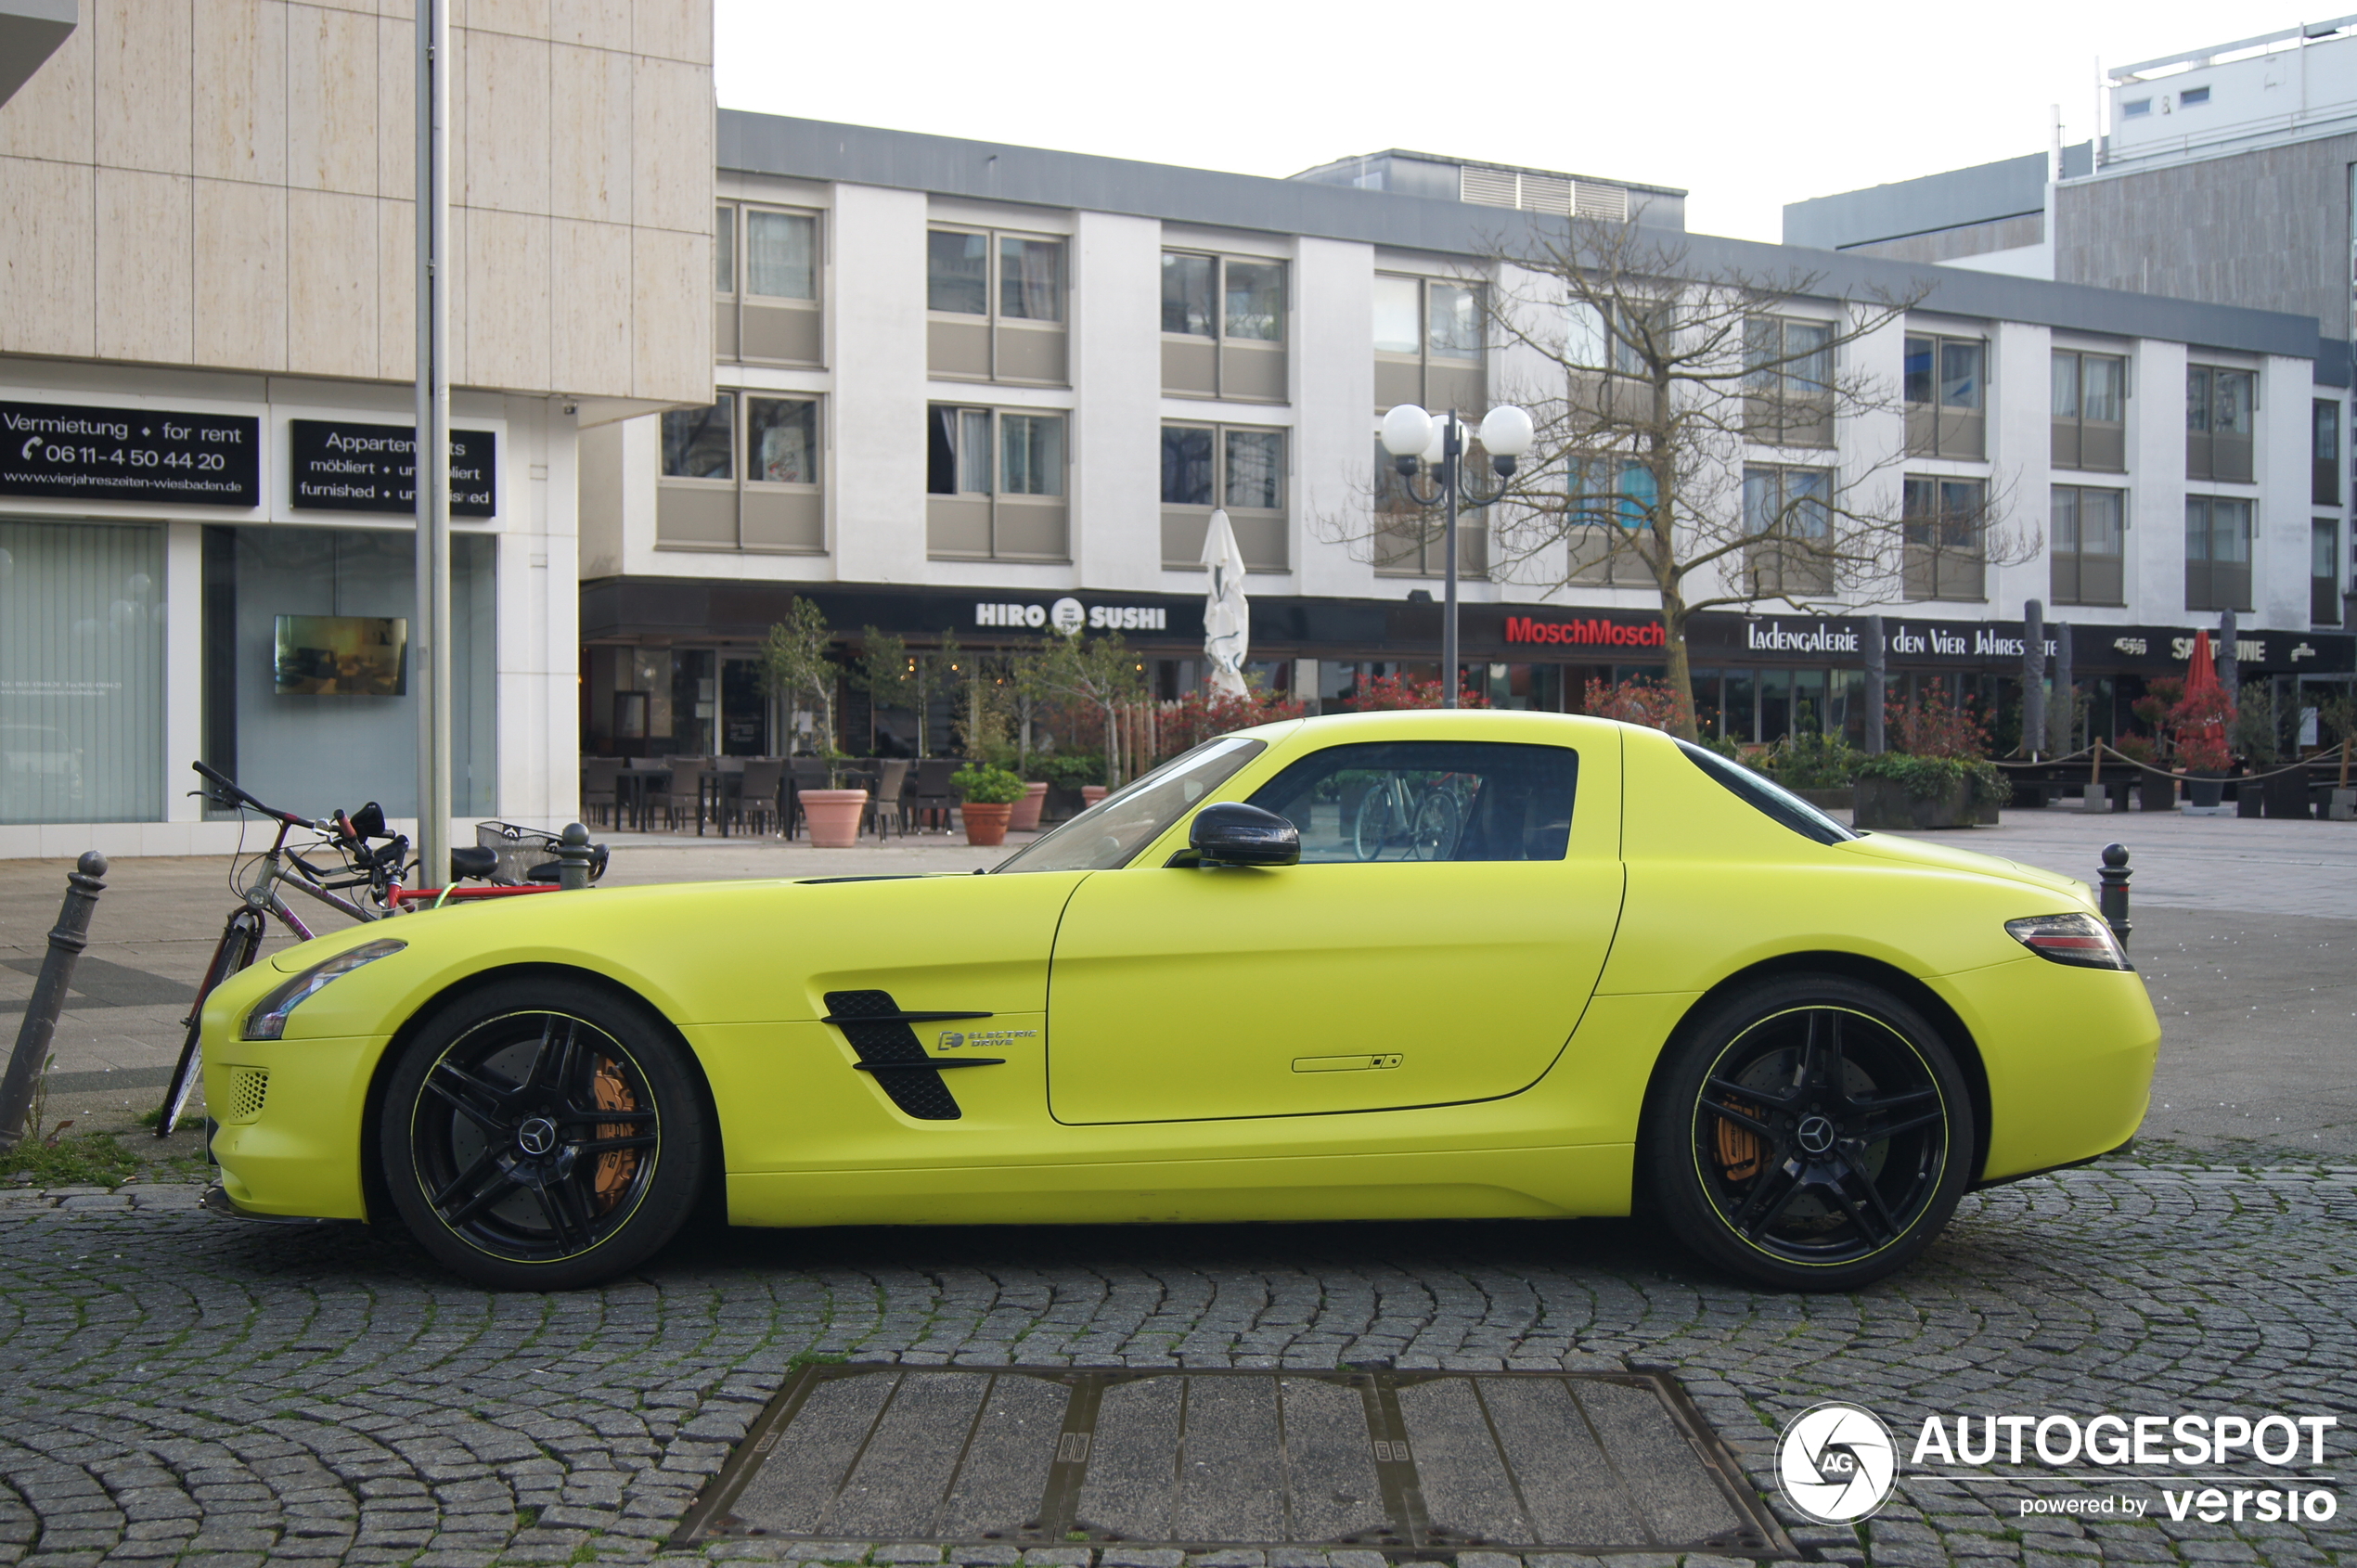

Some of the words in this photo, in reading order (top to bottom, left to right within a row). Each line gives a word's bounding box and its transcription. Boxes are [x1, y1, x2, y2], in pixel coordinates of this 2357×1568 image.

[4, 413, 128, 440] Vermietung
[162, 422, 192, 440] for
[200, 428, 242, 443] rent
[311, 460, 375, 475] möbliert
[5, 472, 242, 493] www.vierjahreszeiten-wiesbaden.de
[301, 482, 375, 498] furnished
[976, 604, 1047, 628] HIRO
[1088, 606, 1166, 630] SUSHI
[1506, 617, 1667, 646] MoschMosch
[968, 1030, 1037, 1039] ELECTRIC
[971, 1038, 1014, 1047] DRIVE
